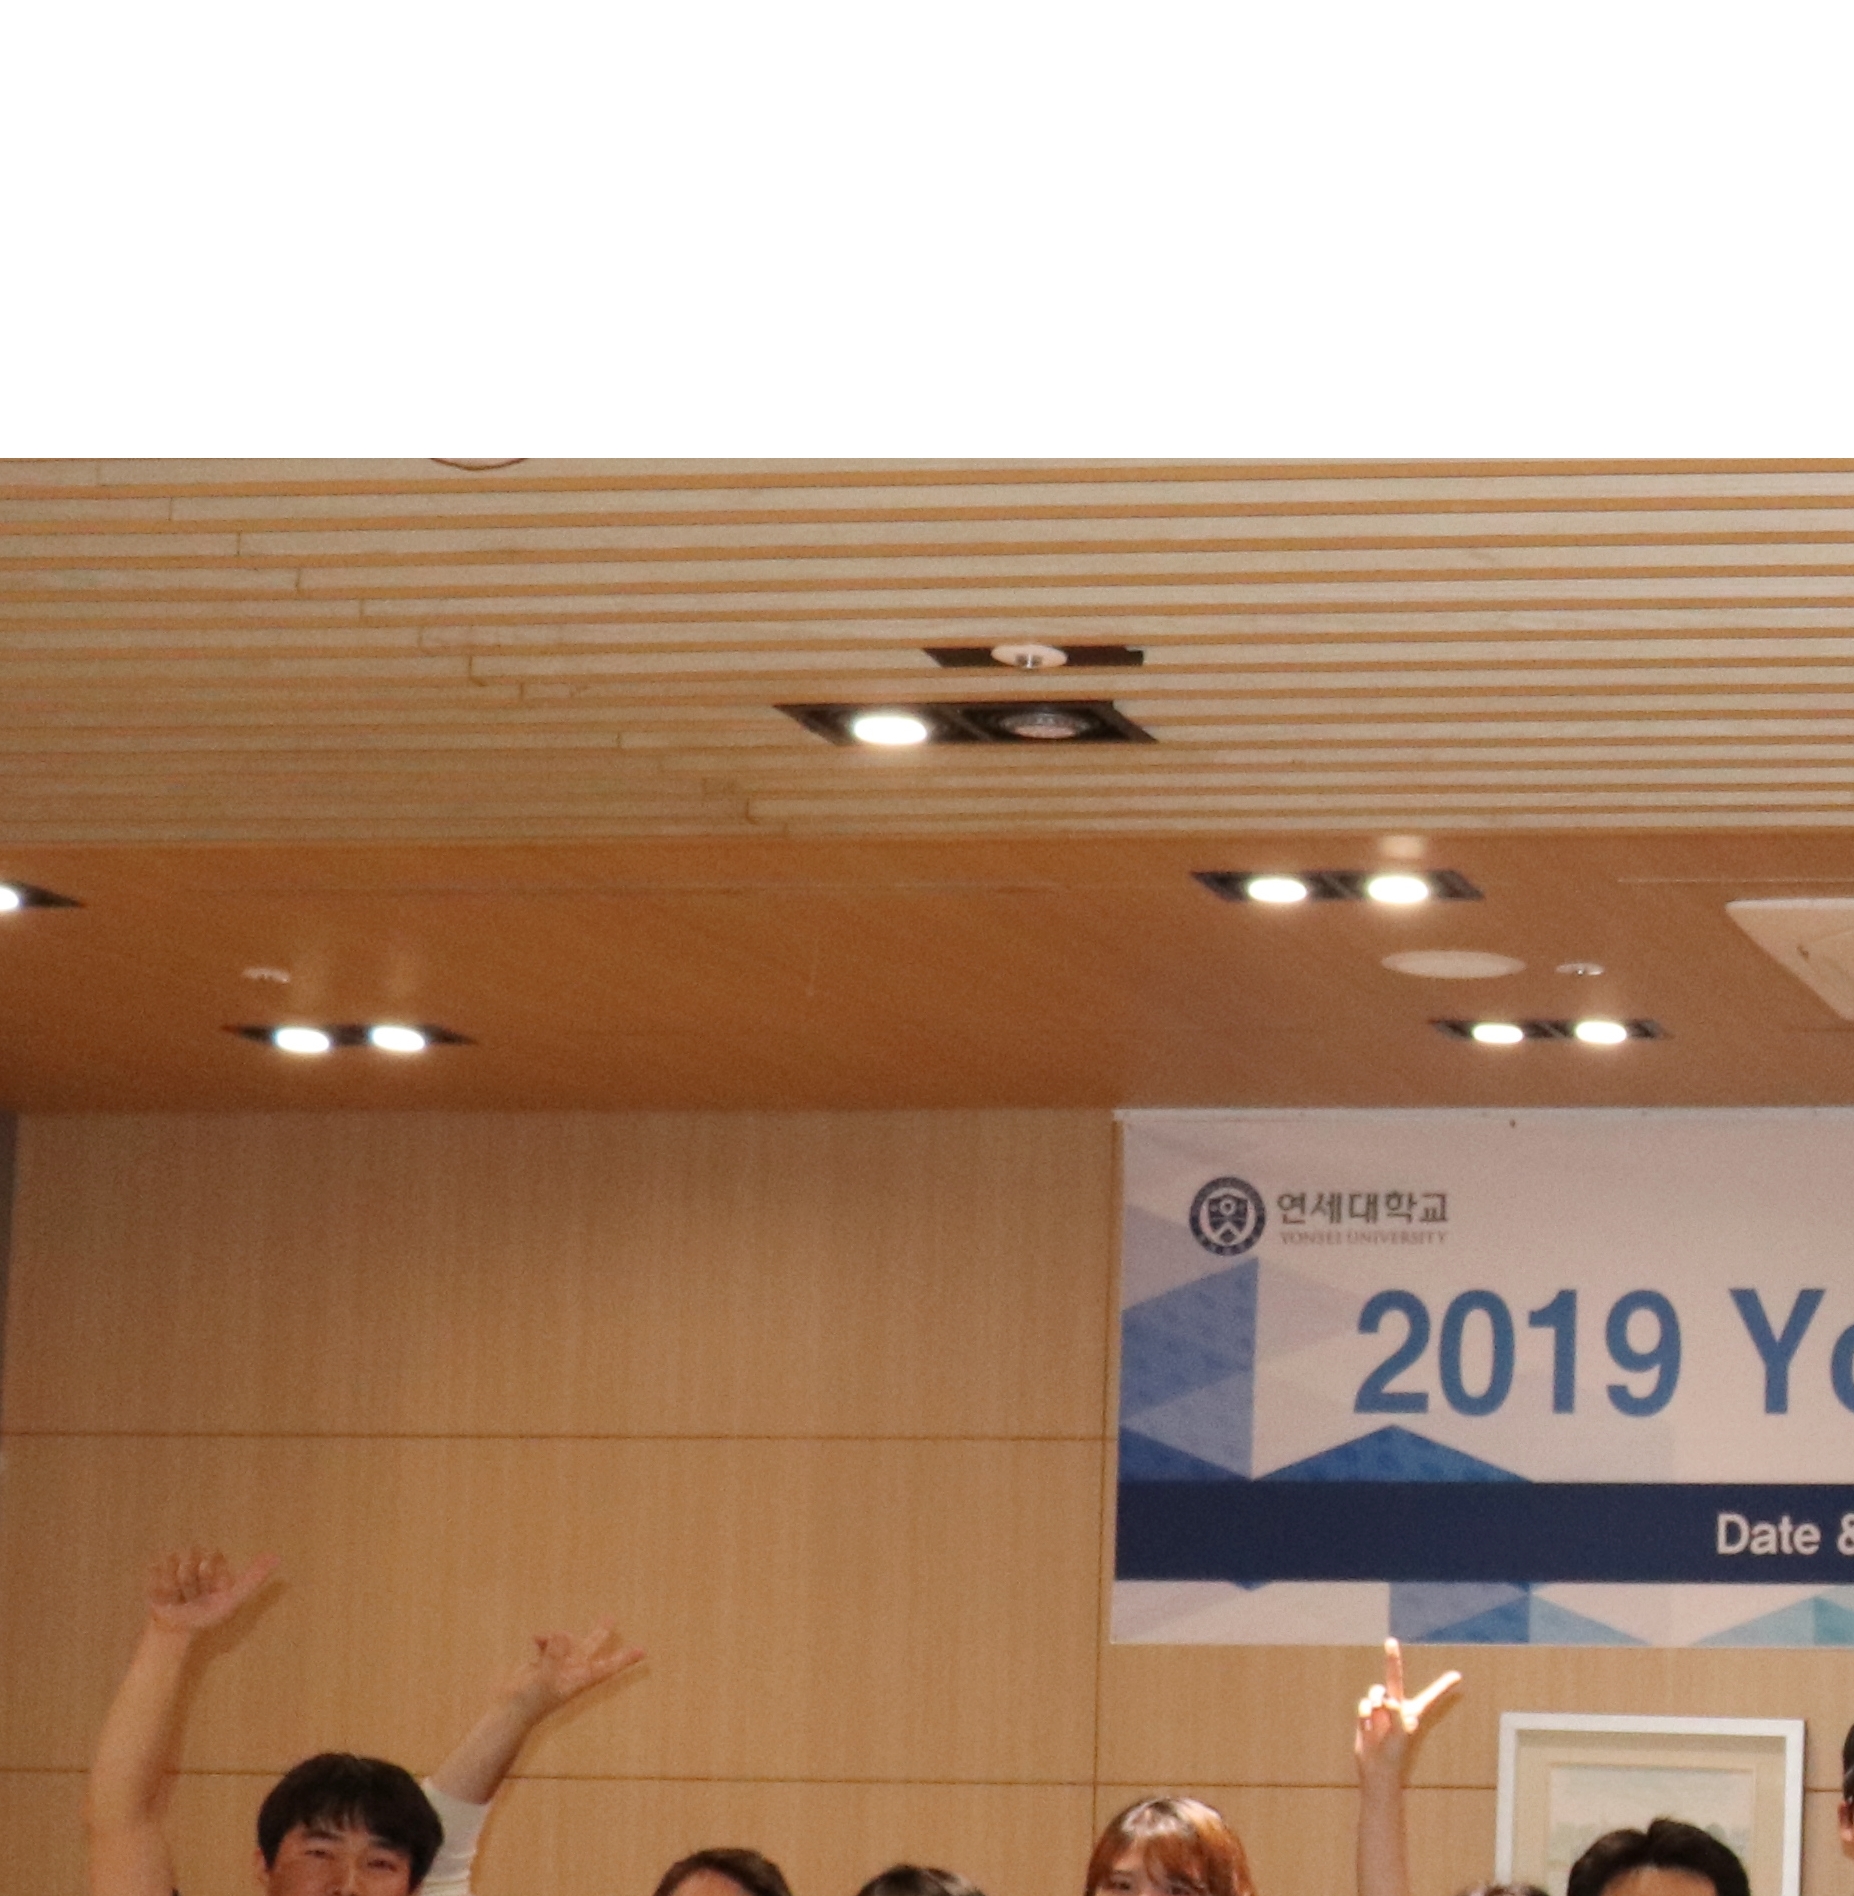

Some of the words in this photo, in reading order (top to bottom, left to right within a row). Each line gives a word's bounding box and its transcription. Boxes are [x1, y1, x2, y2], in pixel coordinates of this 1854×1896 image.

[1277, 1192, 1449, 1225] 연세대학교
[1281, 1230, 1343, 1246] YONSEI
[1349, 1230, 1449, 1246] UNIVERSITY
[1352, 1288, 1682, 1418] 2019
[1716, 1512, 1822, 1556] Date
